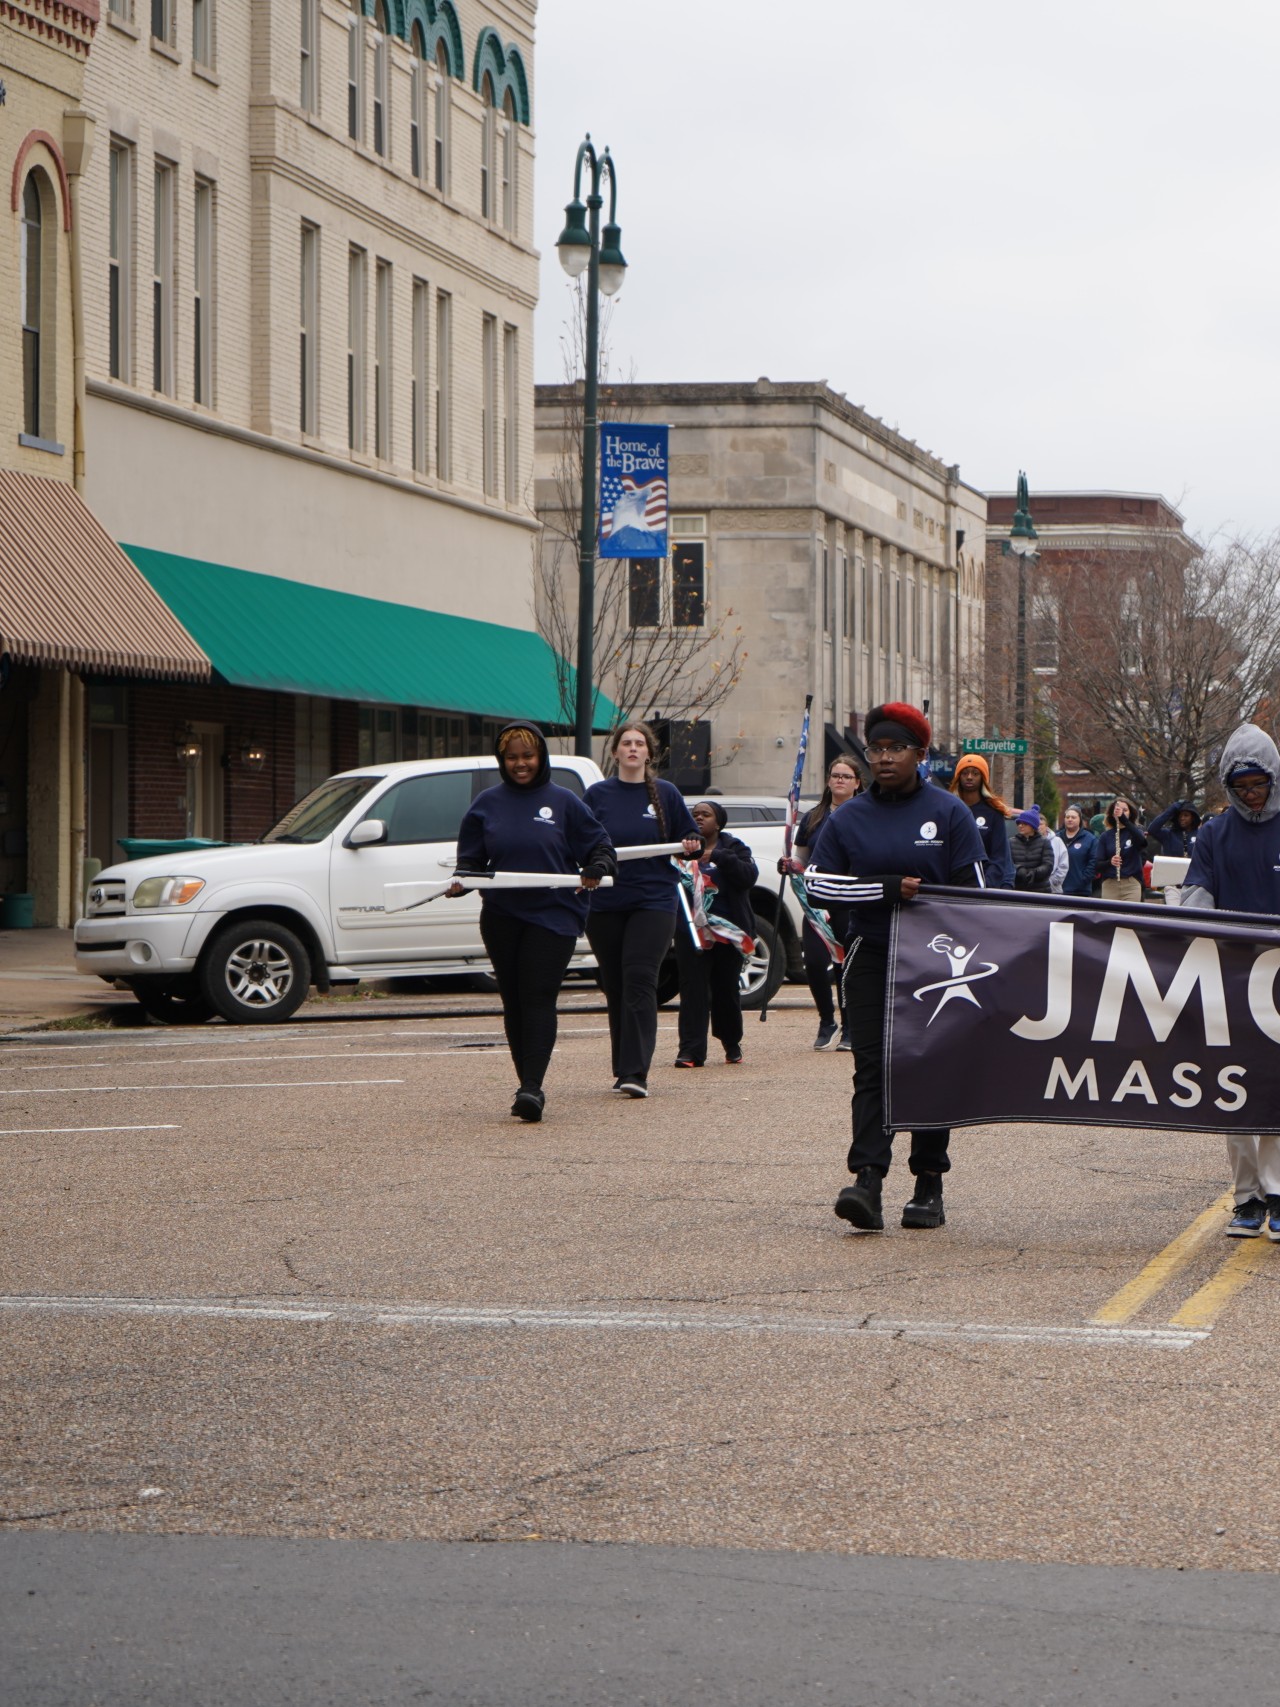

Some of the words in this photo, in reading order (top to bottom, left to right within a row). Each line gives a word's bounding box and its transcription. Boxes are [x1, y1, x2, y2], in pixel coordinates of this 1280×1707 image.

[605, 436, 647, 455] Home
[647, 442, 661, 458] of
[607, 455, 622, 467] the
[622, 453, 665, 473] Brave
[966, 740, 973, 750] E
[974, 738, 1016, 752] Lafayette
[1043, 1056, 1248, 1112] MASS
